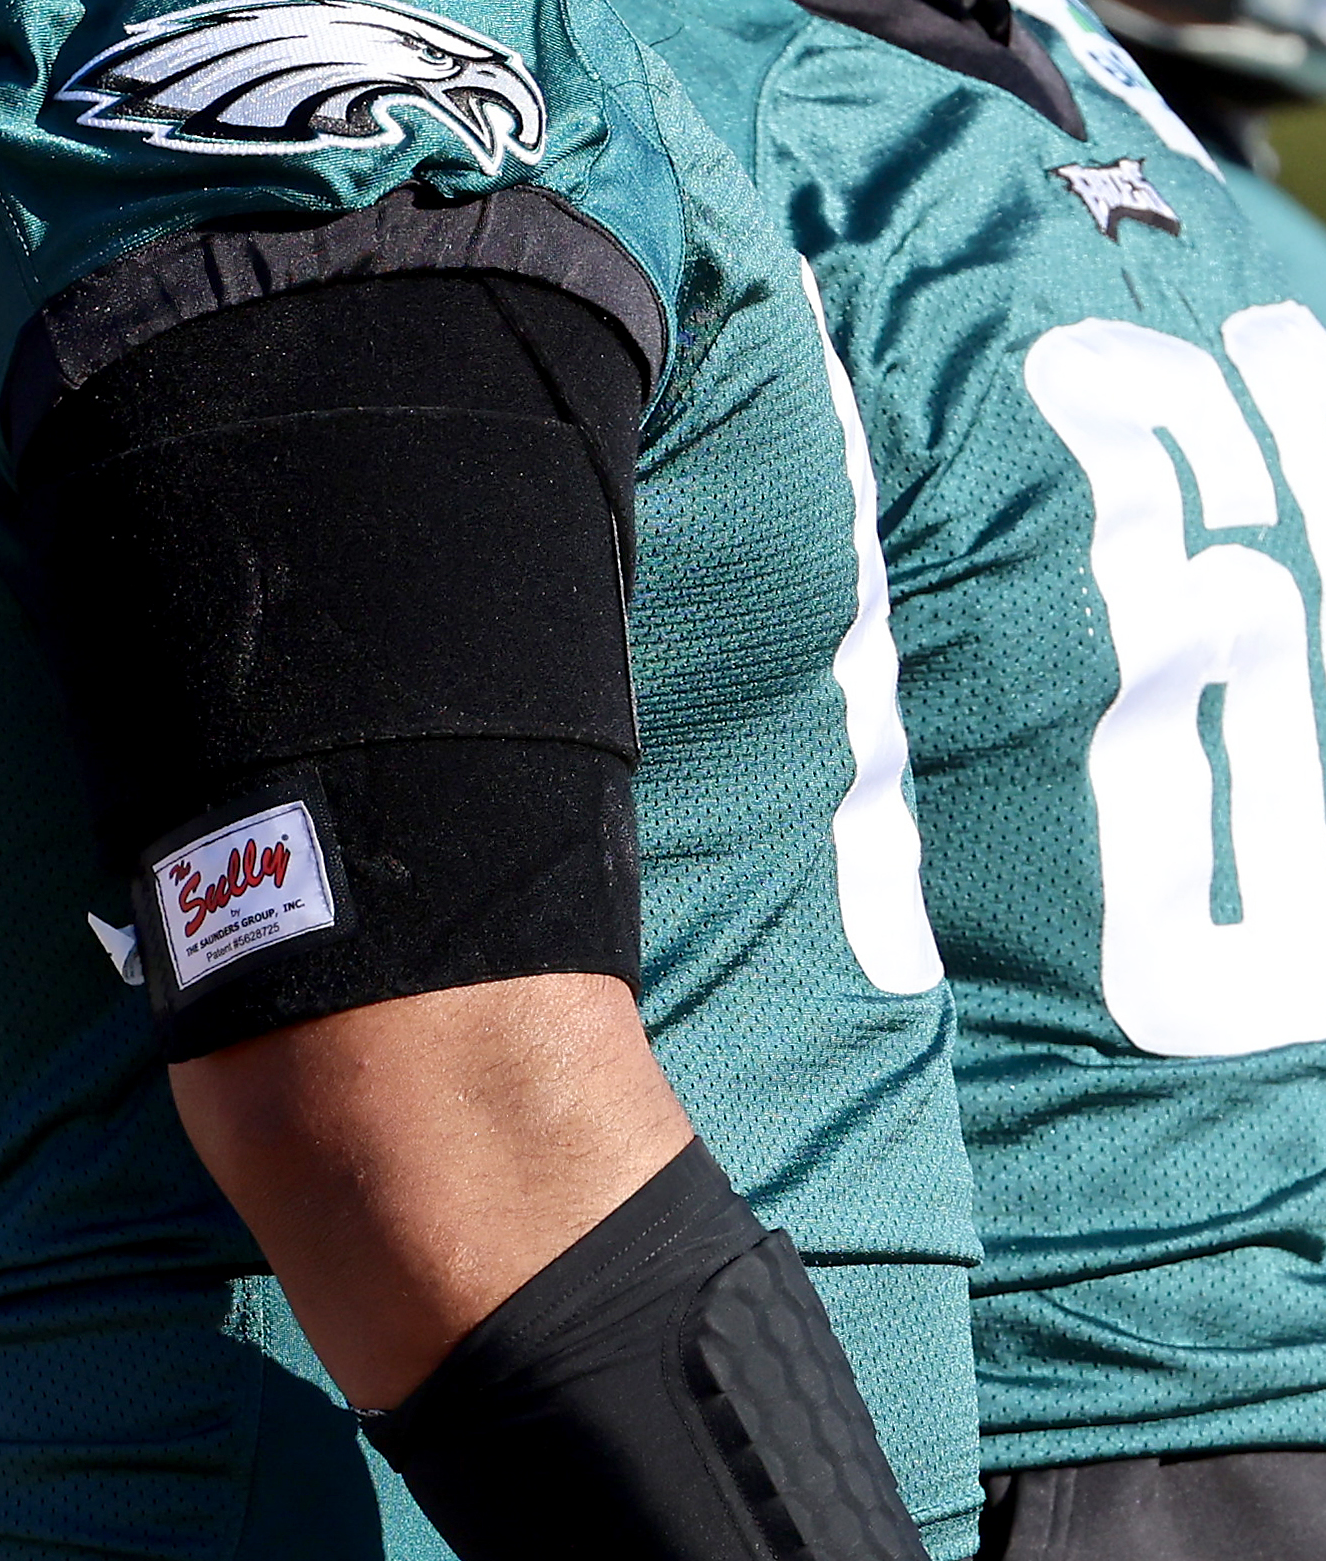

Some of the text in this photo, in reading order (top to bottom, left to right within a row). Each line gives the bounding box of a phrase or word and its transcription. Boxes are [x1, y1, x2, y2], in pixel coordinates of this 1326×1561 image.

[178, 838, 291, 938] Sully
[185, 898, 306, 958] THE SAUNDERS GROUP, INC.
[230, 908, 241, 919] by
[205, 941, 234, 963] Patent
